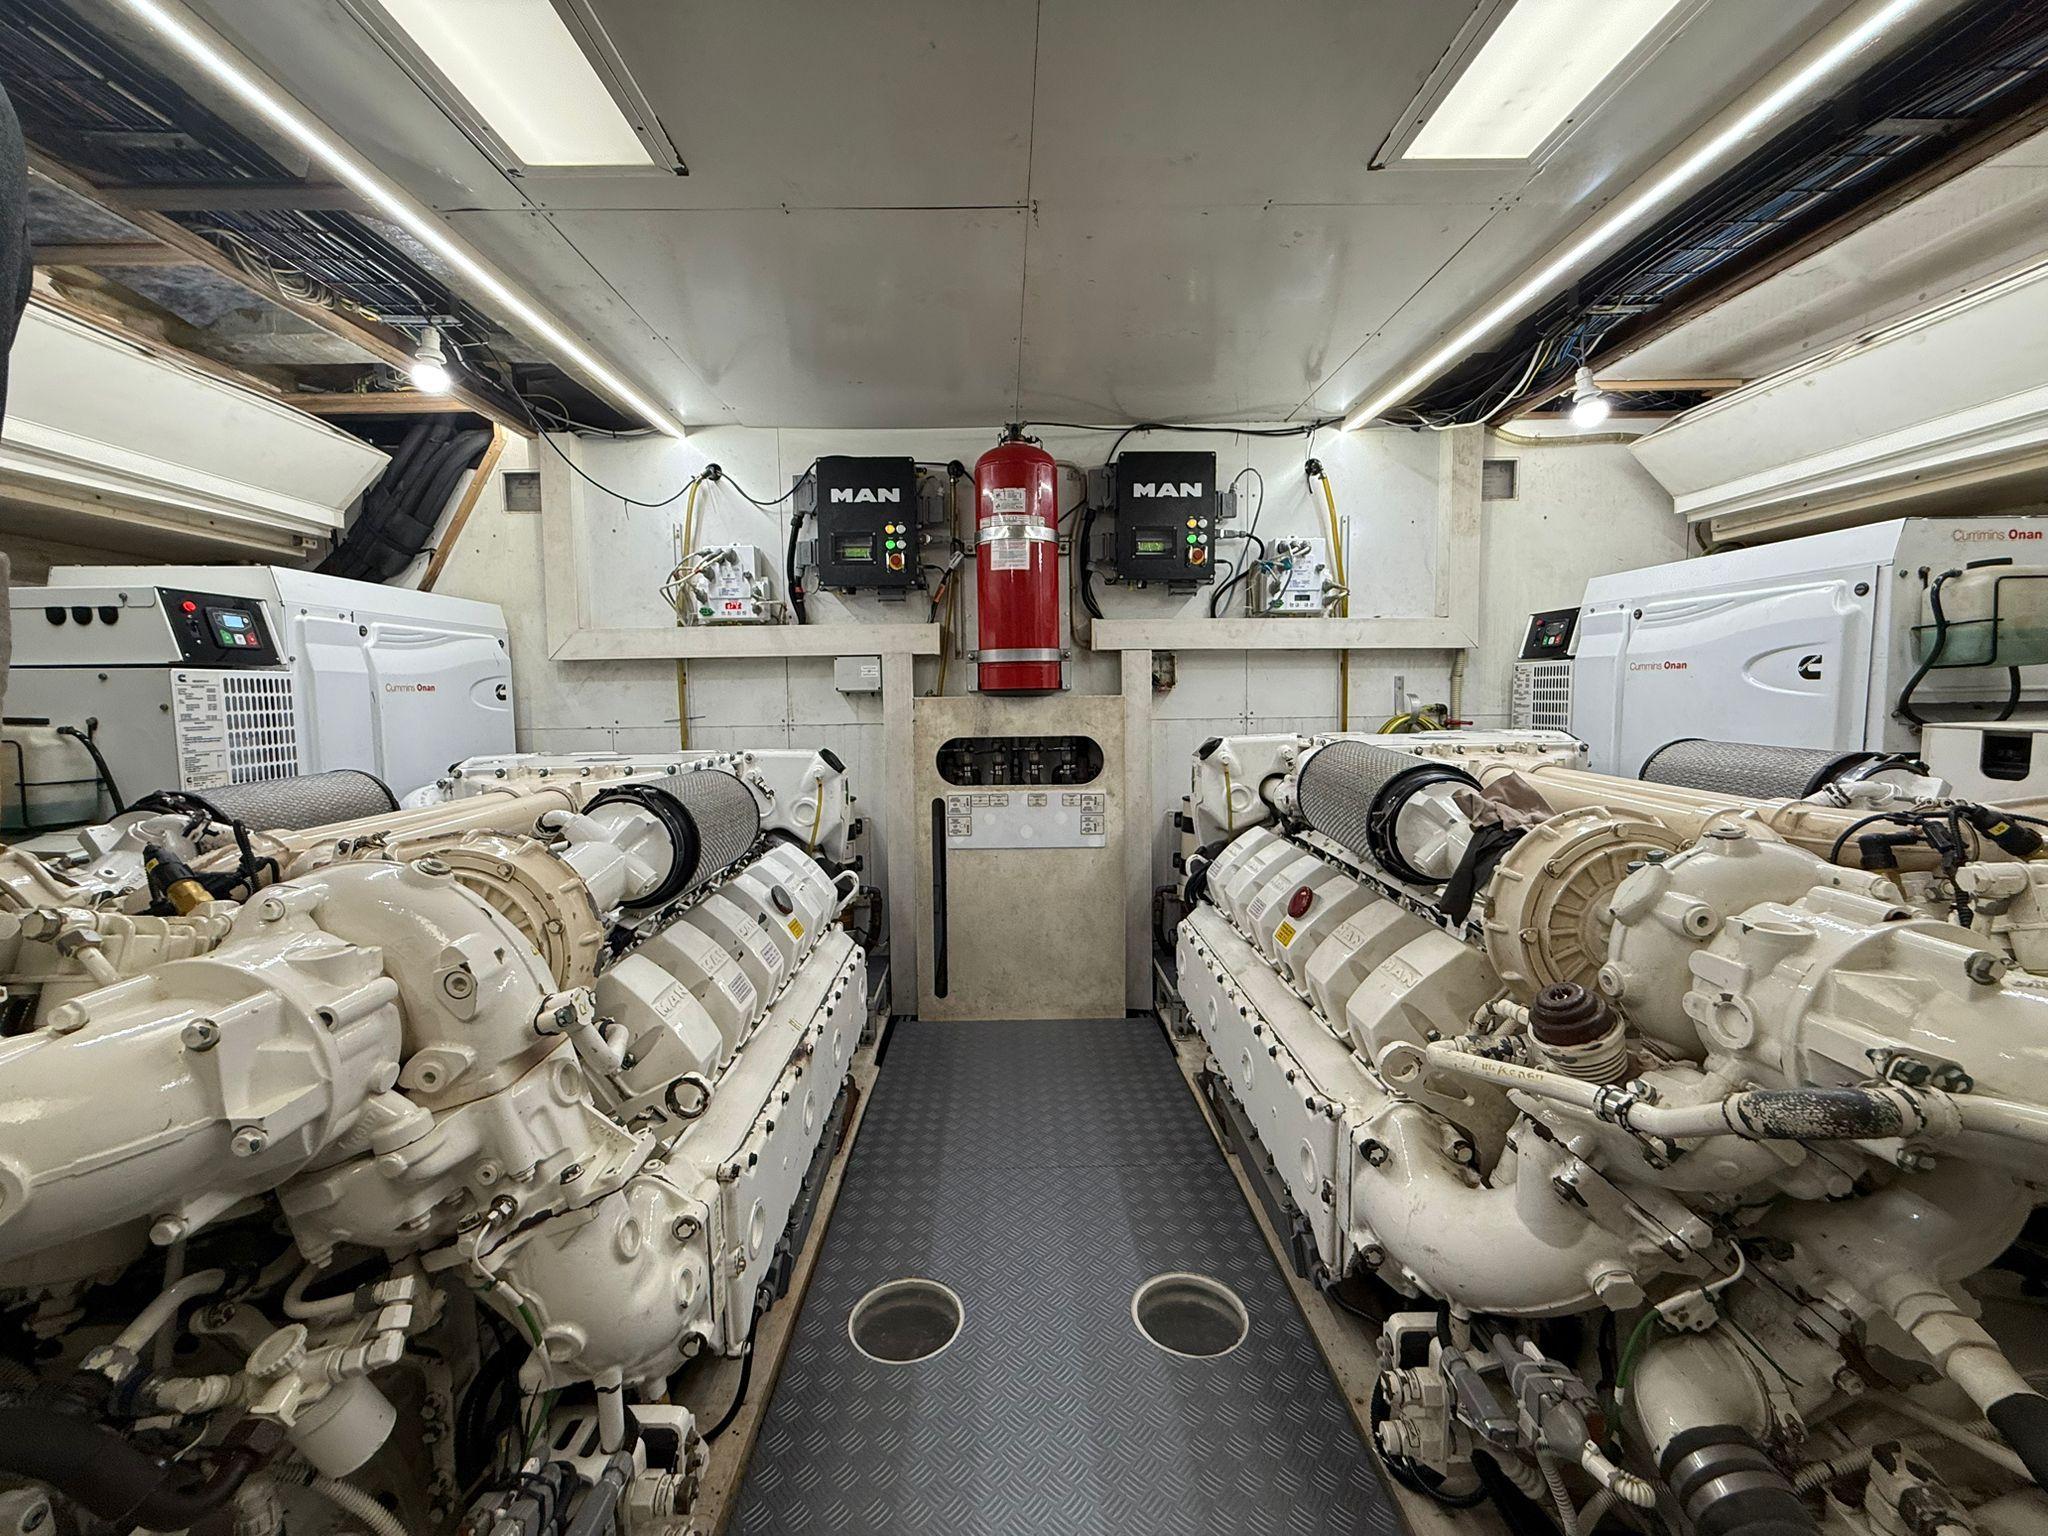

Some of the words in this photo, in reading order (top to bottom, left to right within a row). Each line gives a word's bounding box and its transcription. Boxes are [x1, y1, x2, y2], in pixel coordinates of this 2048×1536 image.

[830, 488, 900, 503] MAN
[1133, 483, 1202, 497] MAN
[1953, 529, 2005, 541] Cummins
[2008, 529, 2042, 540] Onan
[1629, 662, 1662, 671] Cummins
[1664, 661, 1687, 670] Onan
[385, 683, 415, 693] Cummins
[416, 683, 436, 692] Onan
